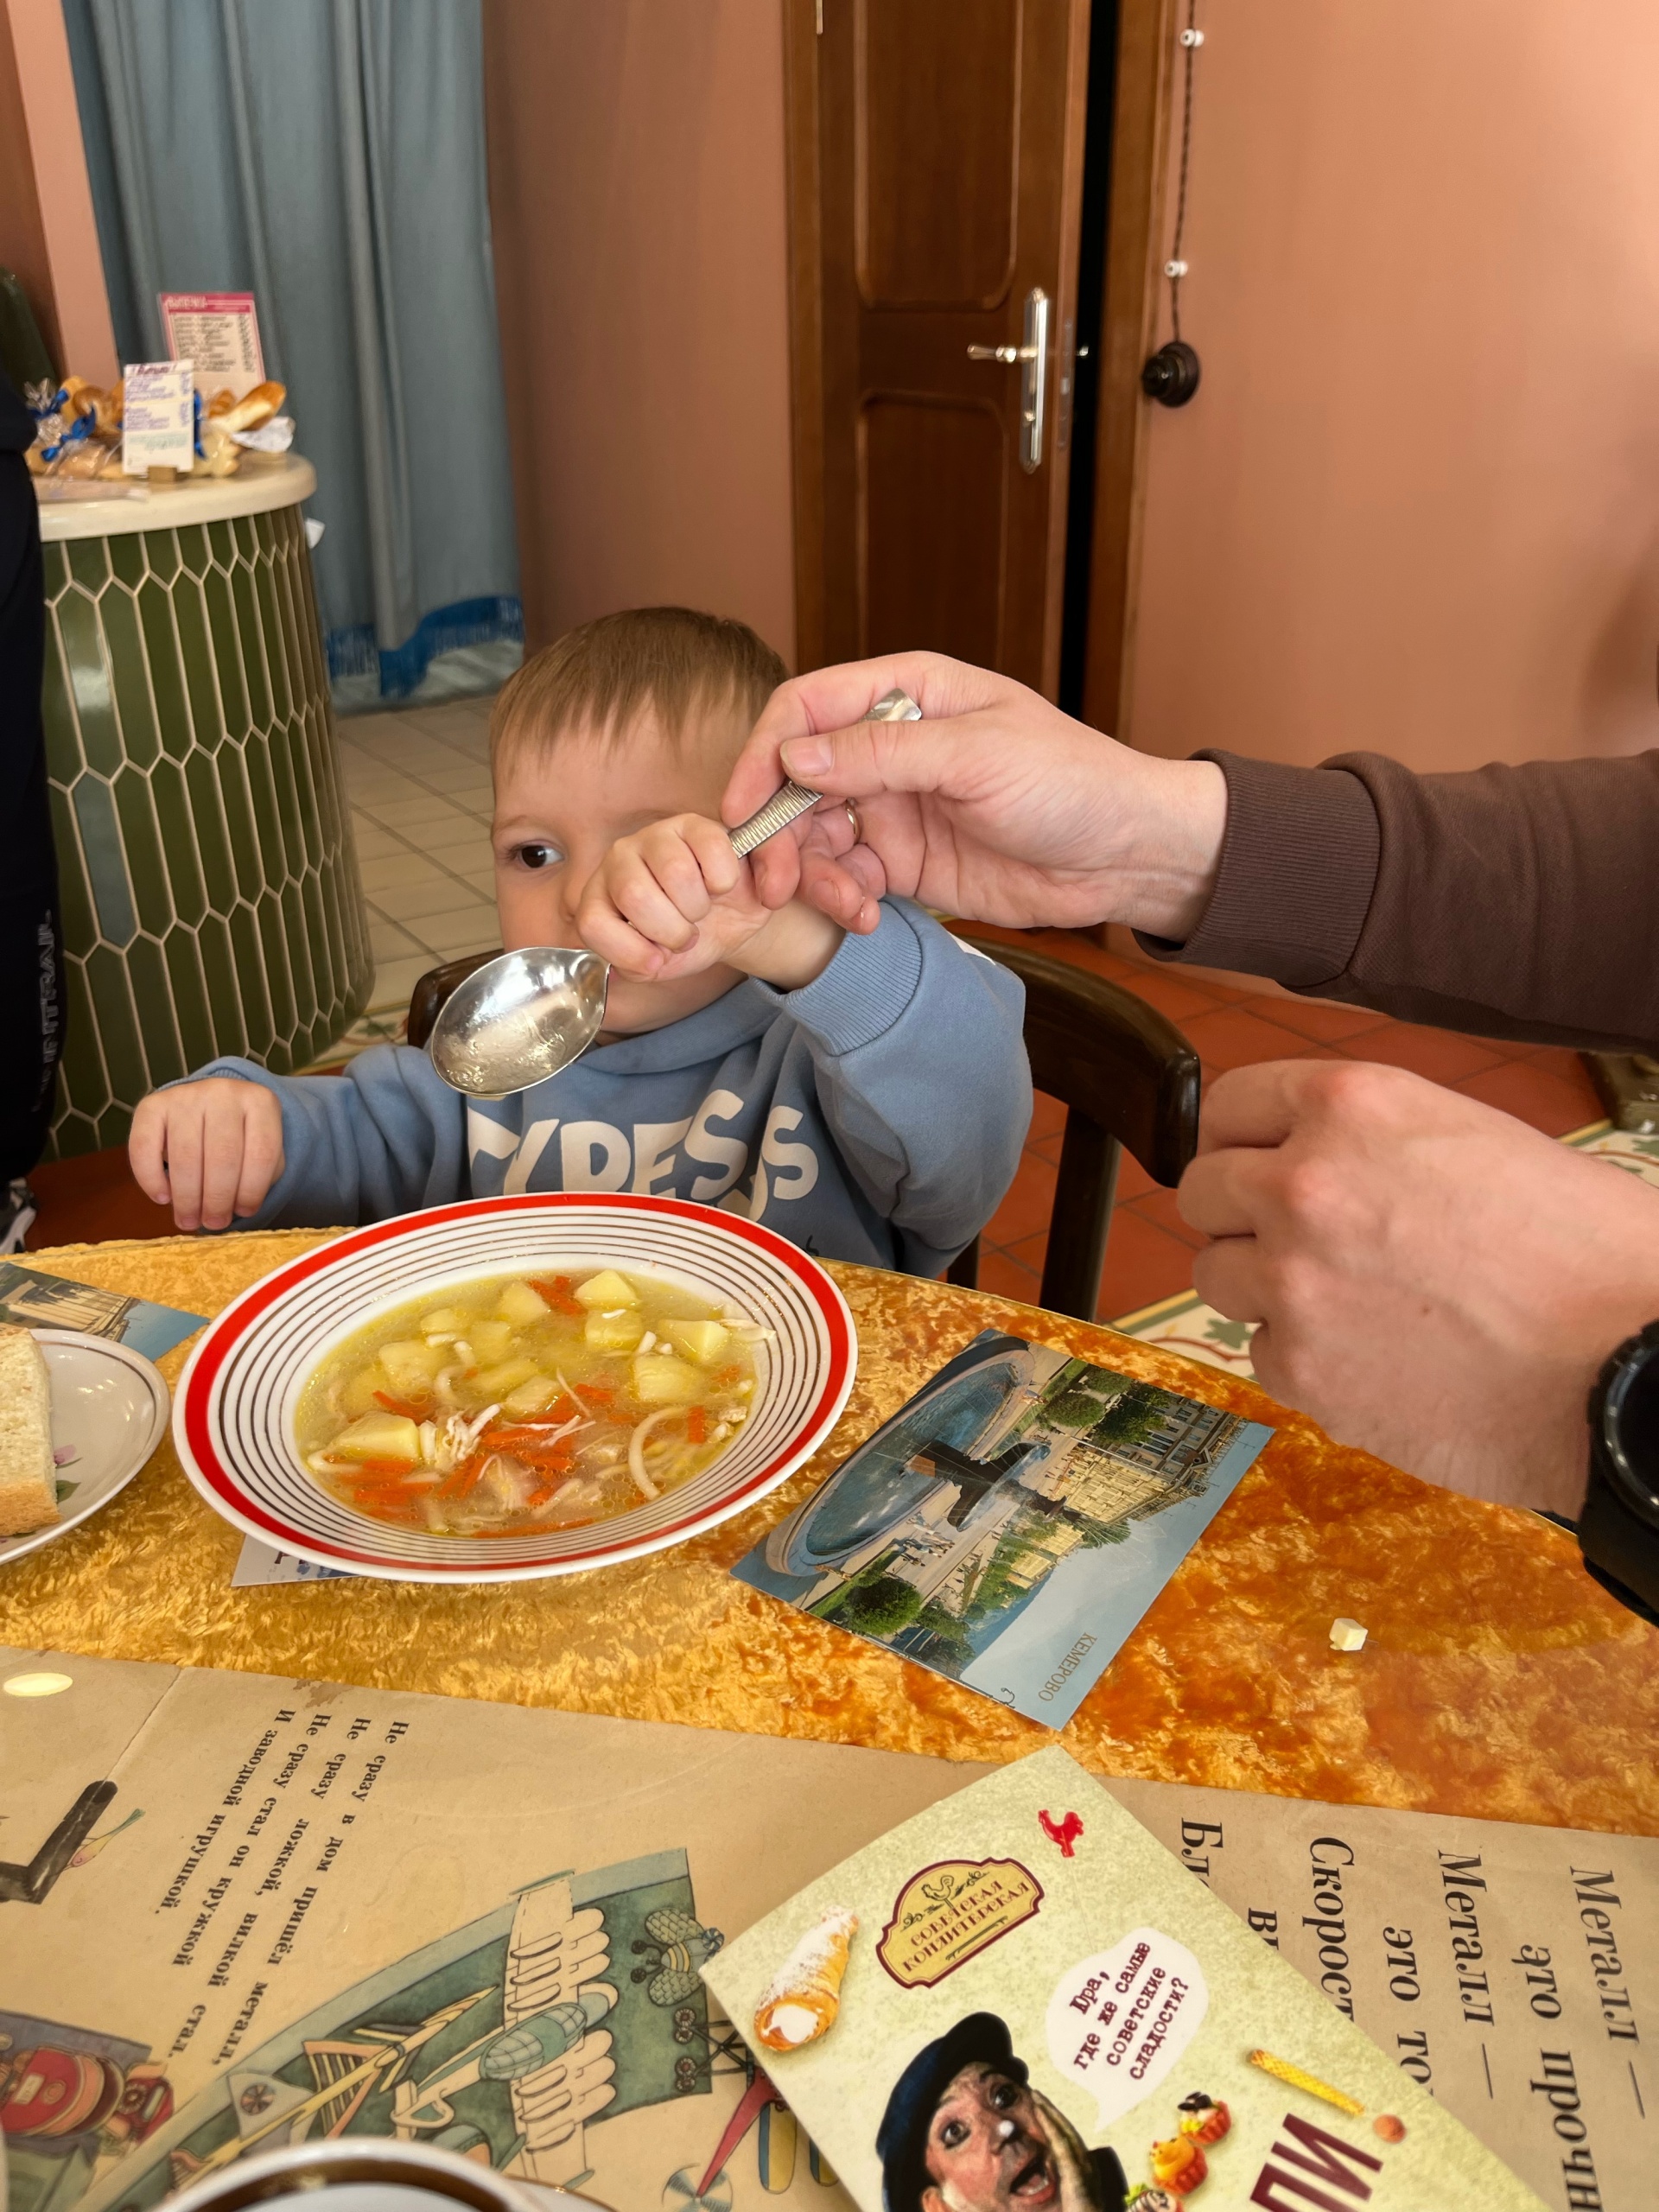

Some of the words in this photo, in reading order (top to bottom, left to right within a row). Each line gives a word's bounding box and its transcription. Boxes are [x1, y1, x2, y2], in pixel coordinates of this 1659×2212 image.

[1038, 1631, 1098, 1701] КЕМЕРОВО
[274, 1708, 297, 1723] И
[305, 1713, 333, 1736] Не
[346, 1717, 372, 1740] Не
[385, 1720, 410, 1745] Не
[222, 1729, 278, 1807] заводной
[273, 1743, 309, 1789] сразу
[310, 1753, 346, 1800] сразу
[351, 1755, 386, 1802] сразу
[246, 1796, 277, 1837] стал
[341, 1814, 356, 1825] в
[155, 1814, 226, 1915] игрушкой.
[228, 1845, 250, 1868] он
[254, 1818, 309, 1897] ложкой,
[316, 1836, 344, 1872] дом
[1180, 1817, 1224, 1889] Бл
[172, 1877, 233, 1967] кружкой
[267, 1886, 319, 1966] пришёл
[902, 1882, 1030, 1972] КОНДИТЕРСКАЯ
[910, 1880, 1003, 1947] СОВЕТСКАЯ
[1437, 1848, 1496, 2026] Металл
[207, 1912, 258, 1987] вилкой
[1382, 1926, 1421, 2002] это
[1511, 1943, 1563, 2020] это
[1569, 1866, 1640, 2044] Металл
[213, 1981, 269, 2065] металл,
[1069, 1971, 1110, 2015] Юра,
[1073, 2032, 1101, 2070] где
[1097, 2000, 1118, 2026] же
[1115, 1942, 1151, 1994] самые
[1106, 1967, 1166, 2066] советские
[168, 2004, 207, 2058] стал.
[1129, 1977, 1189, 2081] сладости?
[1396, 2031, 1434, 2097] то
